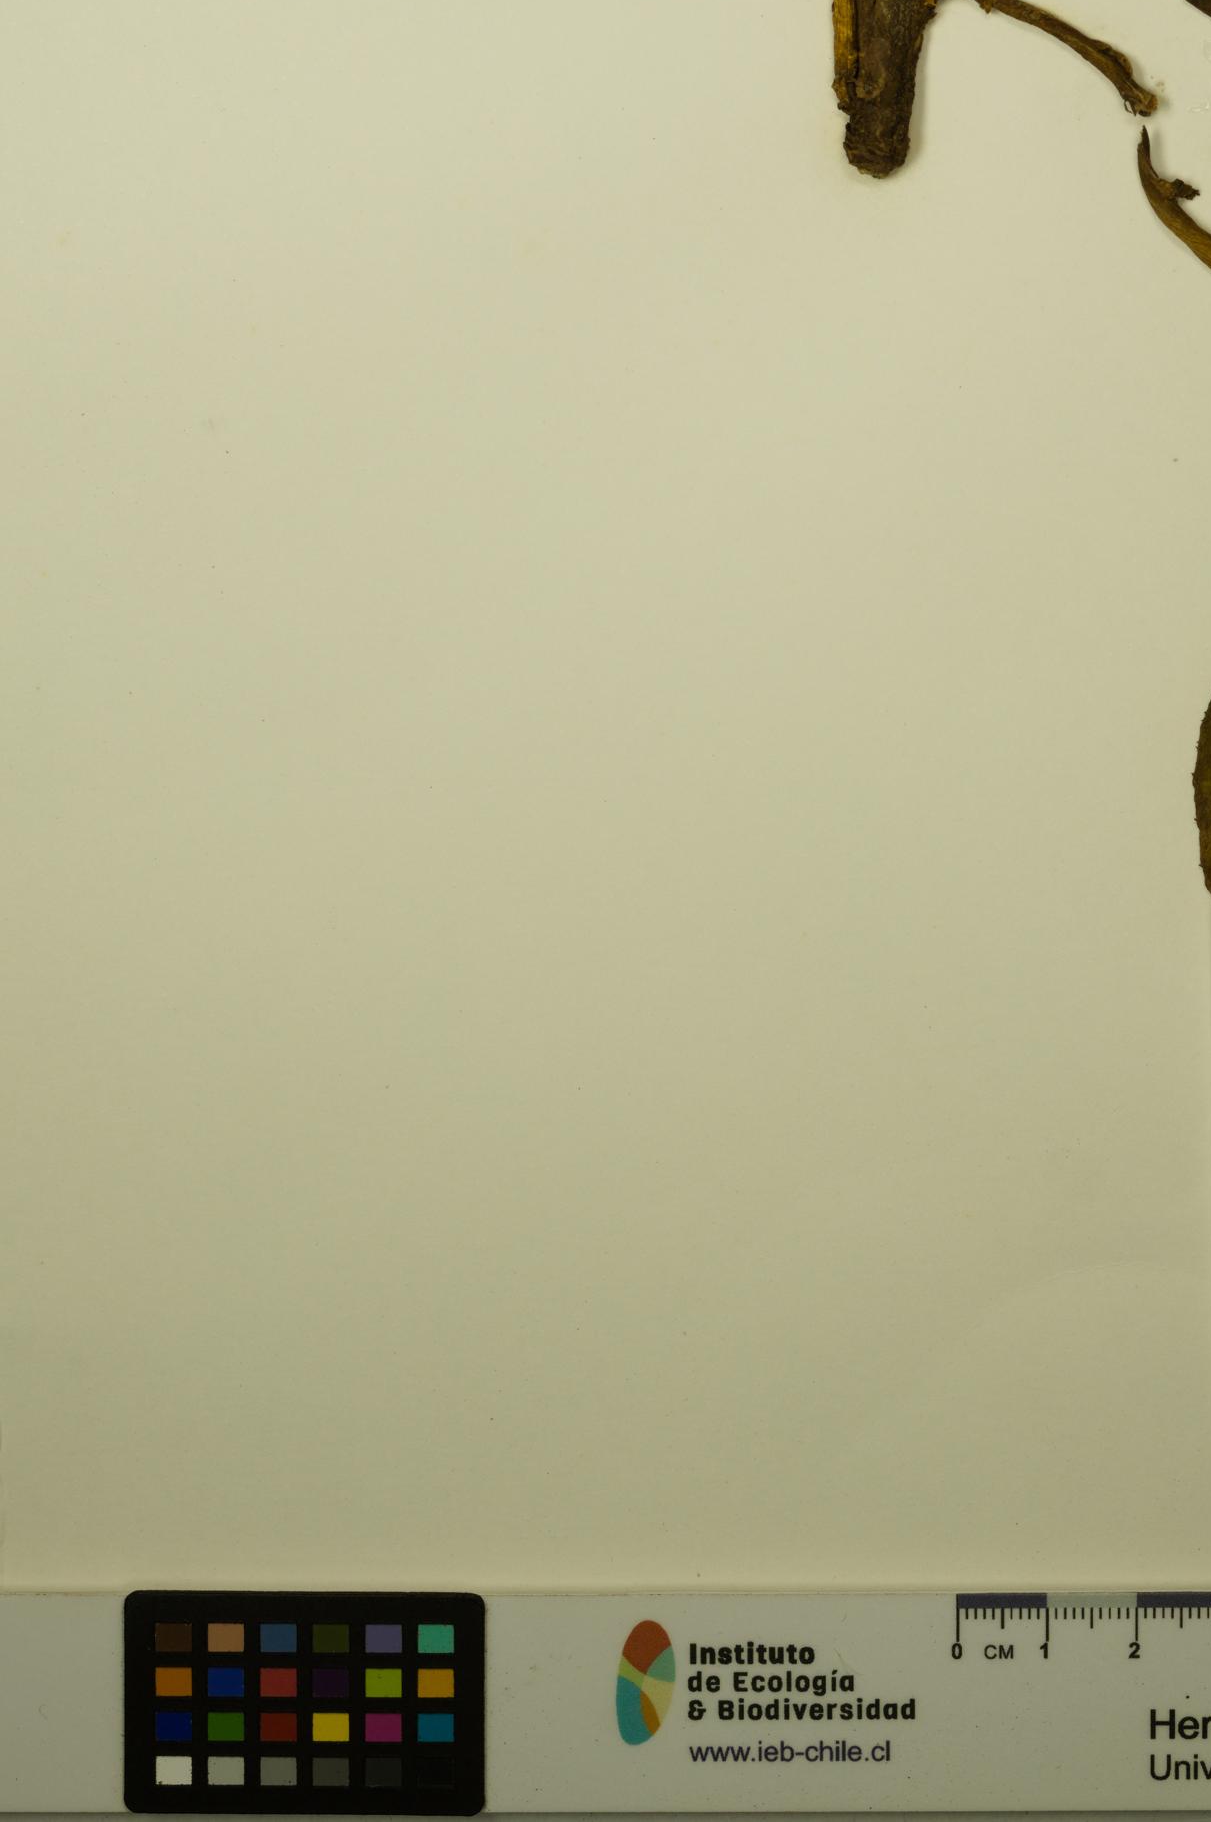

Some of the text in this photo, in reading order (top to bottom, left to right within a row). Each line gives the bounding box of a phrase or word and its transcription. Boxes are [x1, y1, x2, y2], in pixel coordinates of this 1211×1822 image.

[689, 1642, 815, 1665] Instituto
[951, 1642, 963, 1660] 0
[984, 1644, 1014, 1660] CM
[1039, 1642, 1049, 1660] 1
[1128, 1641, 1141, 1660] 2
[688, 1668, 855, 1695] de Ecología
[688, 1697, 917, 1722] & Biodiversidad
[688, 1739, 892, 1763] www.ieb-chile.cl
